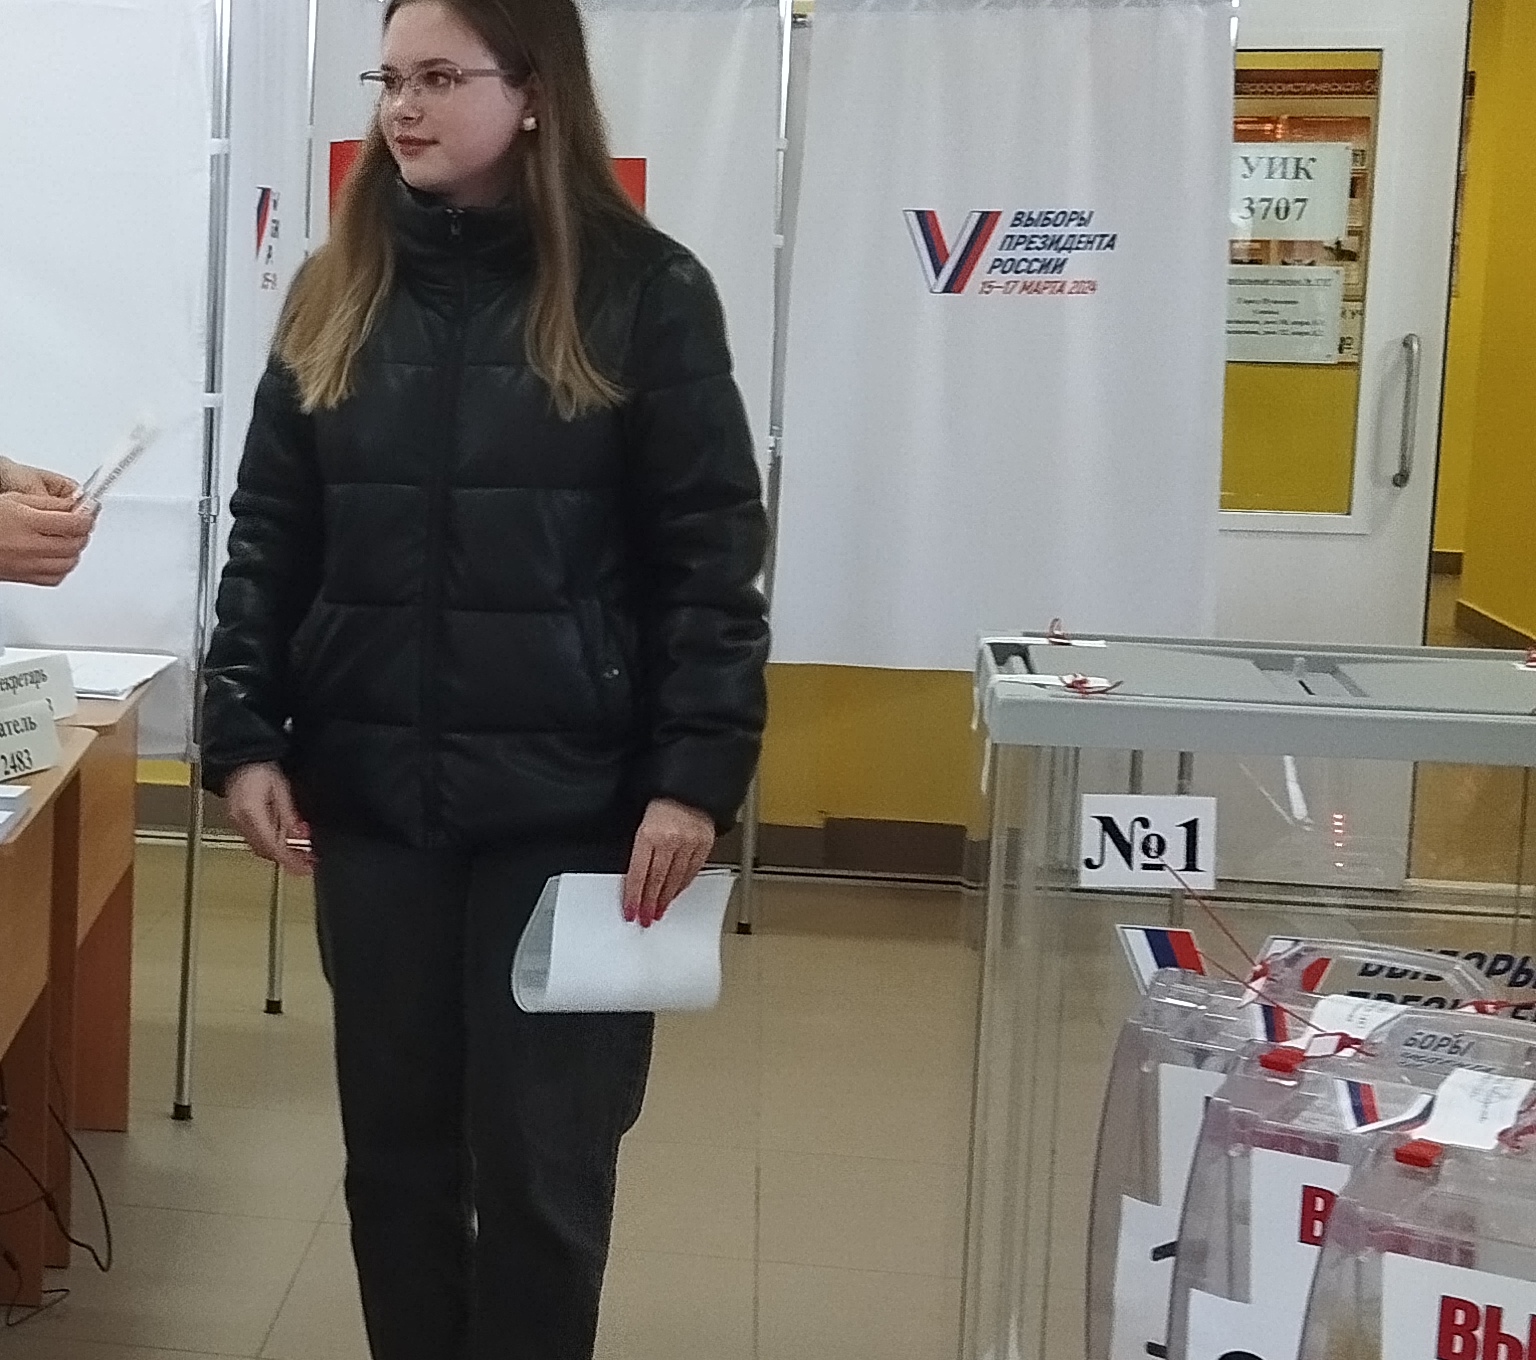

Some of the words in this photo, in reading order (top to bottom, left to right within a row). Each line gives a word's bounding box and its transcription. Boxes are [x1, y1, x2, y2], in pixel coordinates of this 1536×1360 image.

[1239, 155, 1317, 181] УИК
[1009, 210, 1094, 228] ВЫБОРЫ
[1239, 196, 1309, 221] 3707
[997, 233, 1118, 254] ПРЕЗИДЕНТА
[986, 257, 1069, 275] РОССИИ
[0, 748, 33, 776] 2483
[1083, 814, 1207, 873] №1
